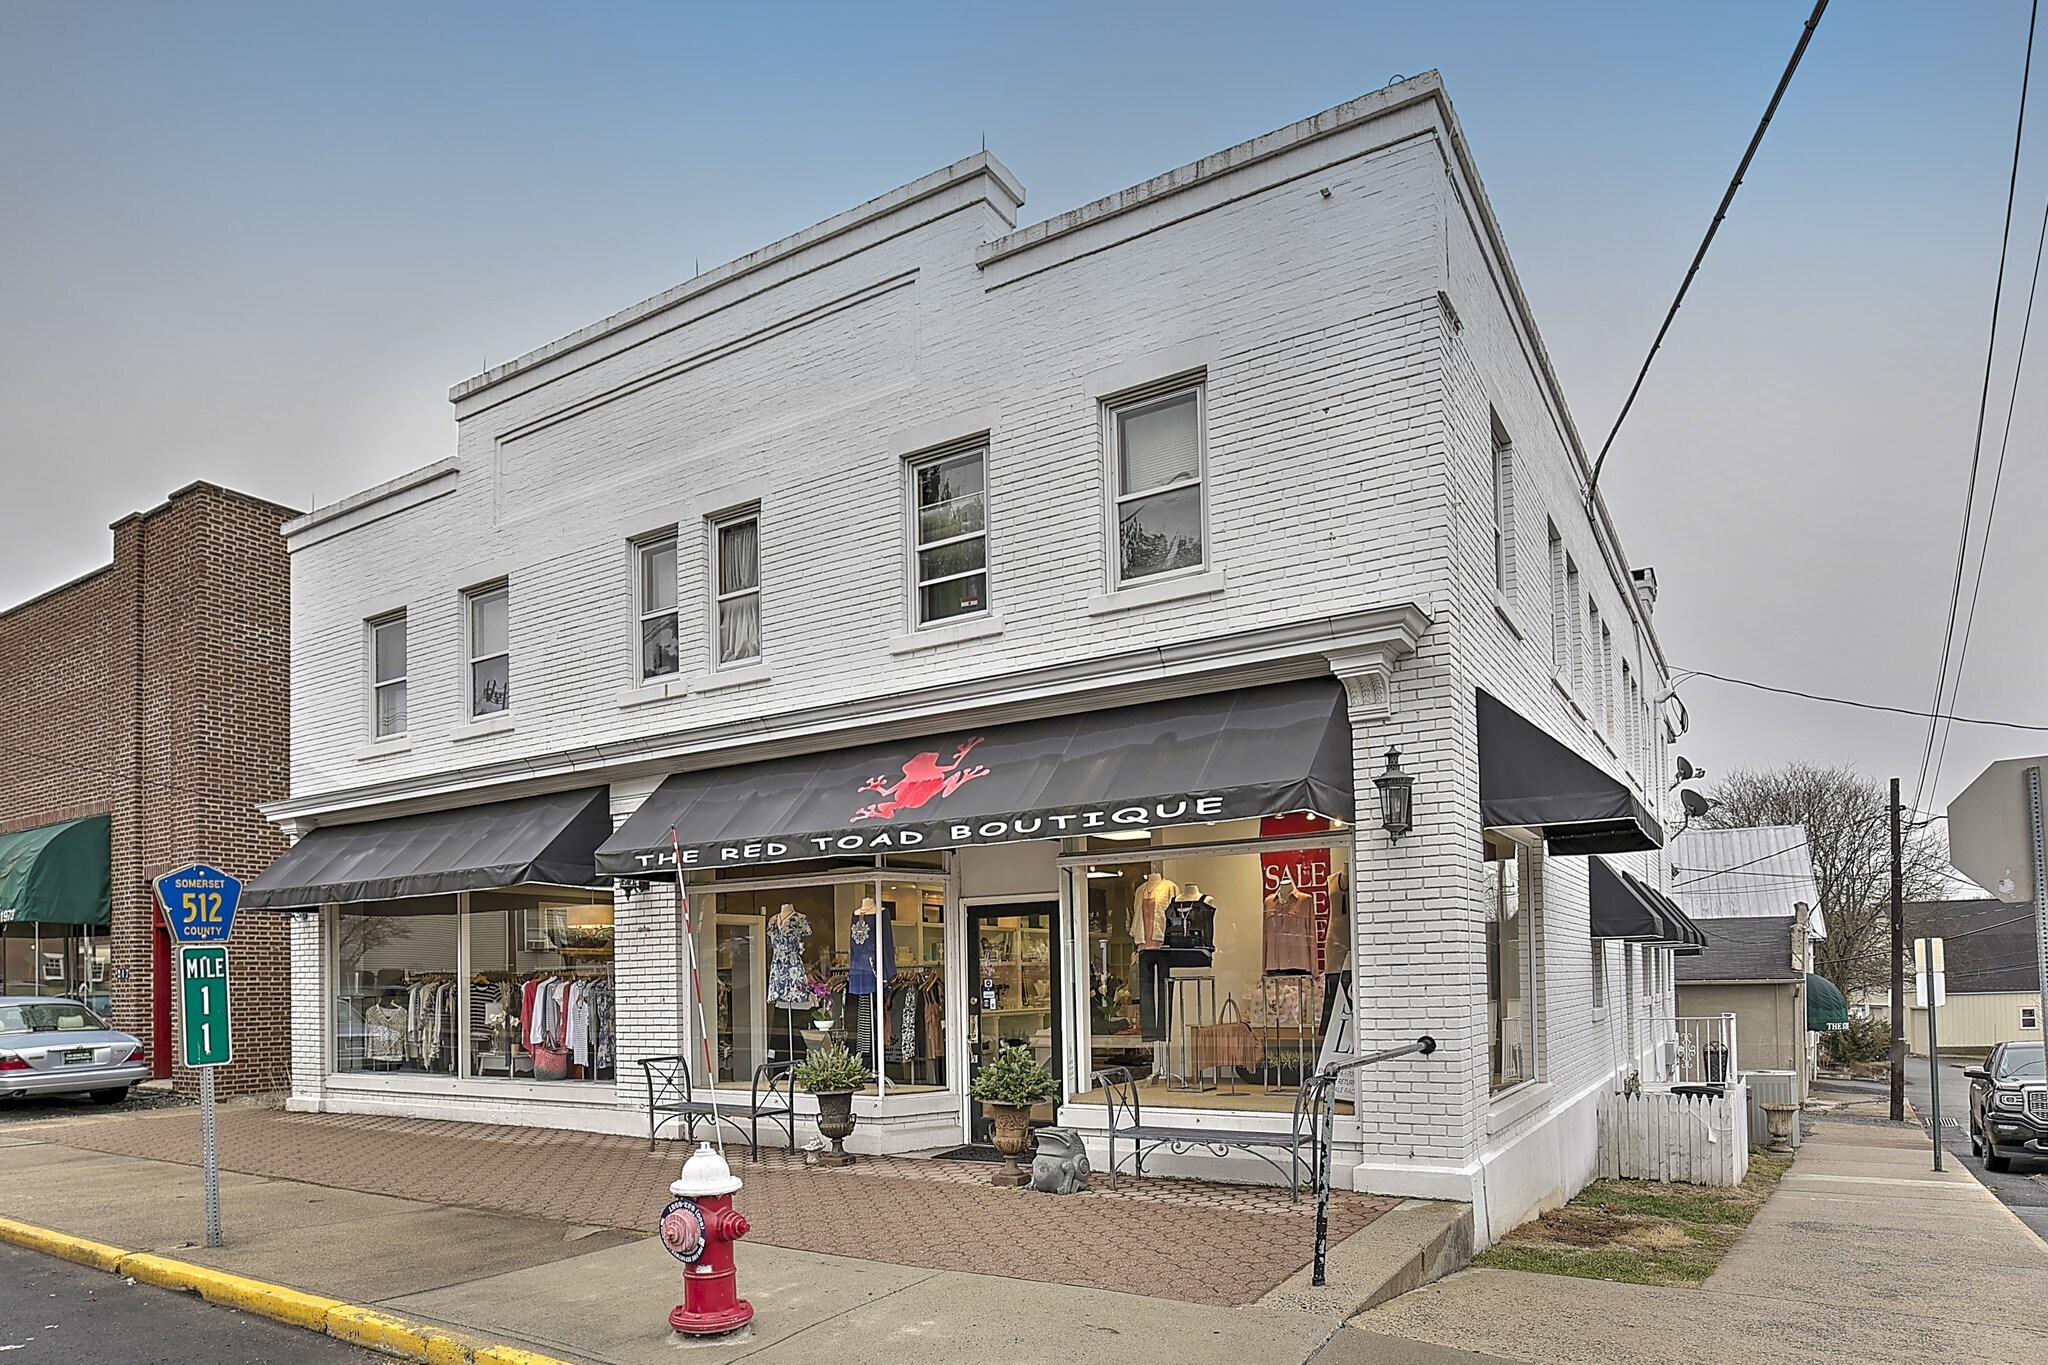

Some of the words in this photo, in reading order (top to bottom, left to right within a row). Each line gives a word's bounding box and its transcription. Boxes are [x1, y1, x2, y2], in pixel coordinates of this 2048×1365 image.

[634, 849, 700, 867] THE
[720, 842, 788, 861] RED
[810, 830, 924, 851] TOAD
[950, 796, 1224, 840] BOUTIQUE
[175, 879, 225, 889] SOMERSET
[1265, 861, 1328, 890] SALE
[182, 892, 223, 923] 512
[183, 926, 222, 936] COUNTY
[186, 957, 225, 979] MILE
[201, 986, 210, 1015] 1
[201, 1022, 210, 1055] 1
